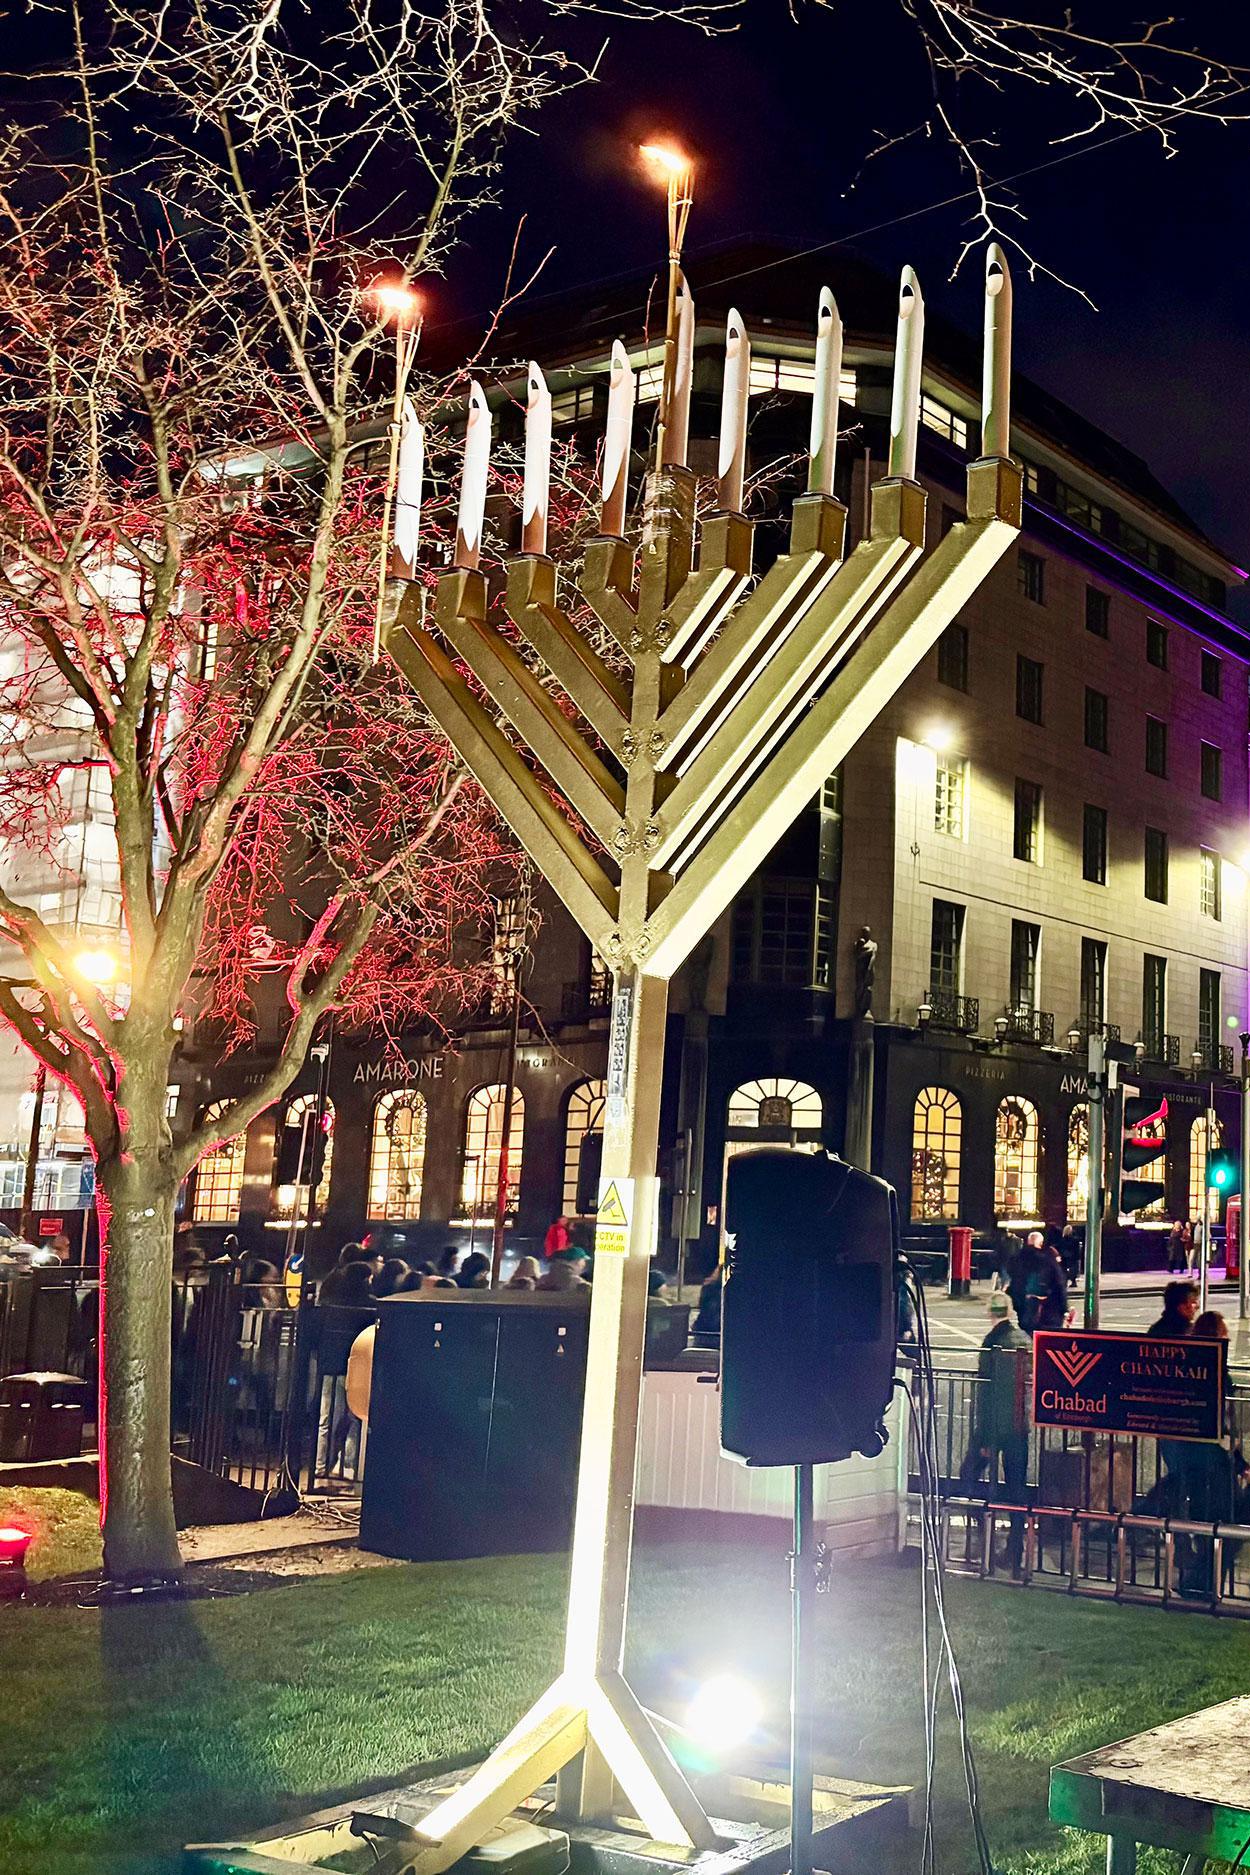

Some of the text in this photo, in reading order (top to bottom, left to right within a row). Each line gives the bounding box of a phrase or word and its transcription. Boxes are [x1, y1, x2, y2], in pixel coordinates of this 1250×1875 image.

[353, 1057, 444, 1082] AMARONE
[1139, 1344, 1187, 1360] HAPPY
[1120, 1361, 1207, 1380] CHANUKAH
[1041, 1389, 1107, 1414] Chabad
